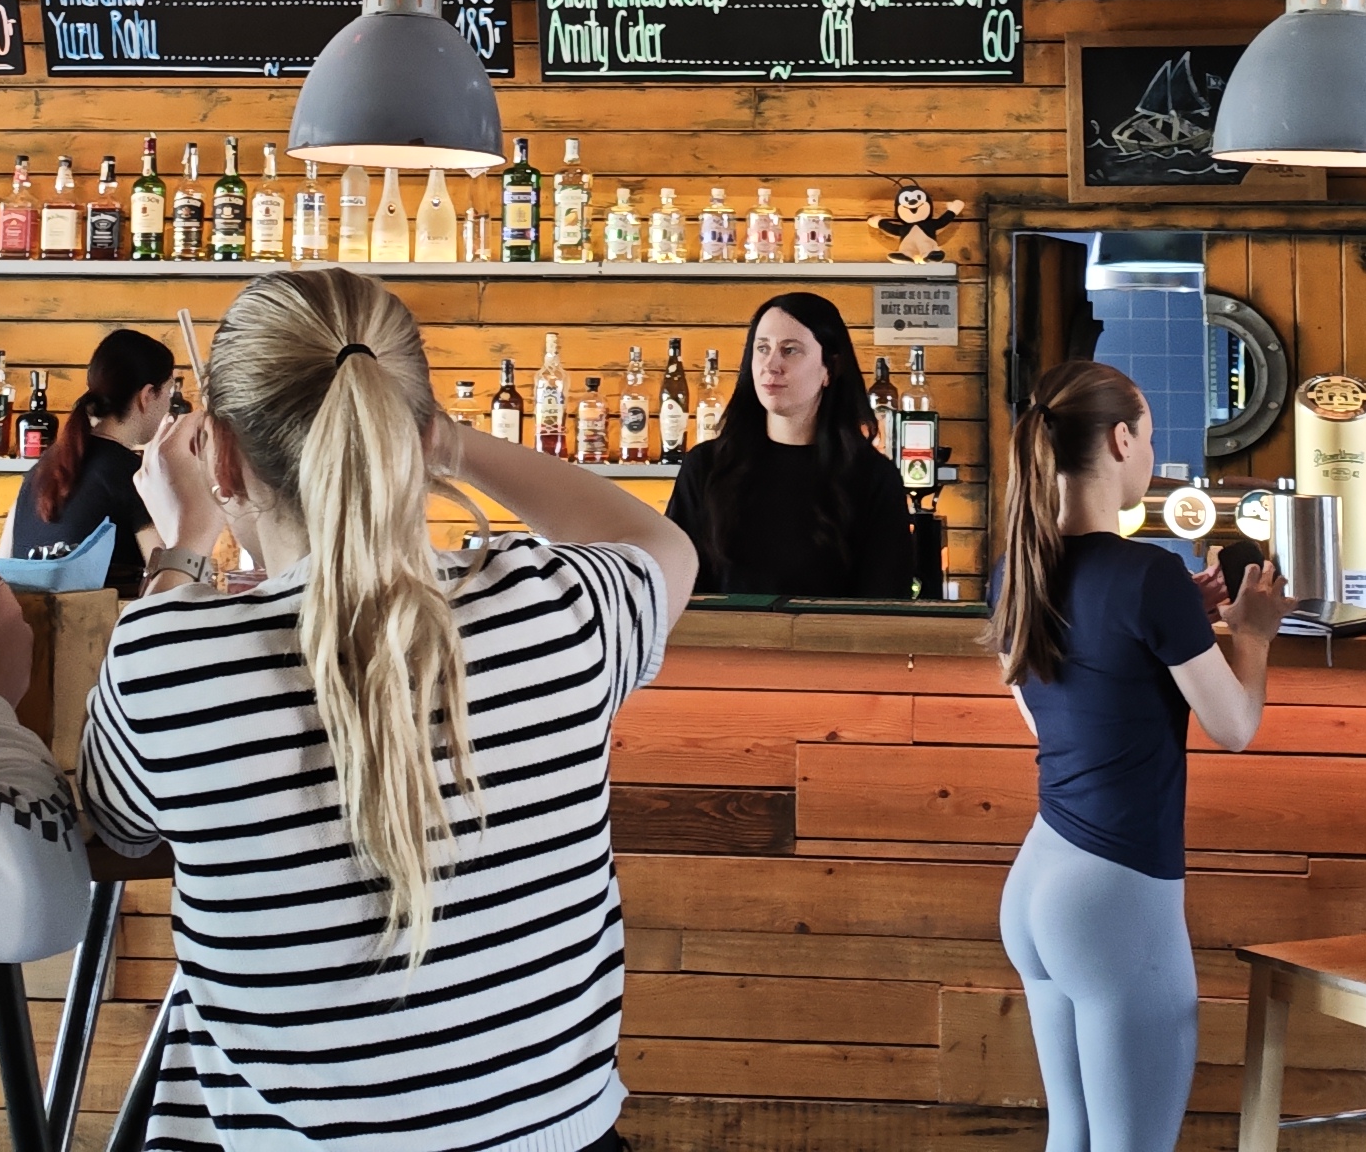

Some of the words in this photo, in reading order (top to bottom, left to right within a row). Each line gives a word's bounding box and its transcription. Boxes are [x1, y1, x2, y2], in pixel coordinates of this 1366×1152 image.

[48, 11, 104, 60] Yuzu
[109, 9, 160, 60] Roku
[548, 9, 609, 73] Amity
[615, 9, 666, 63] Cider
